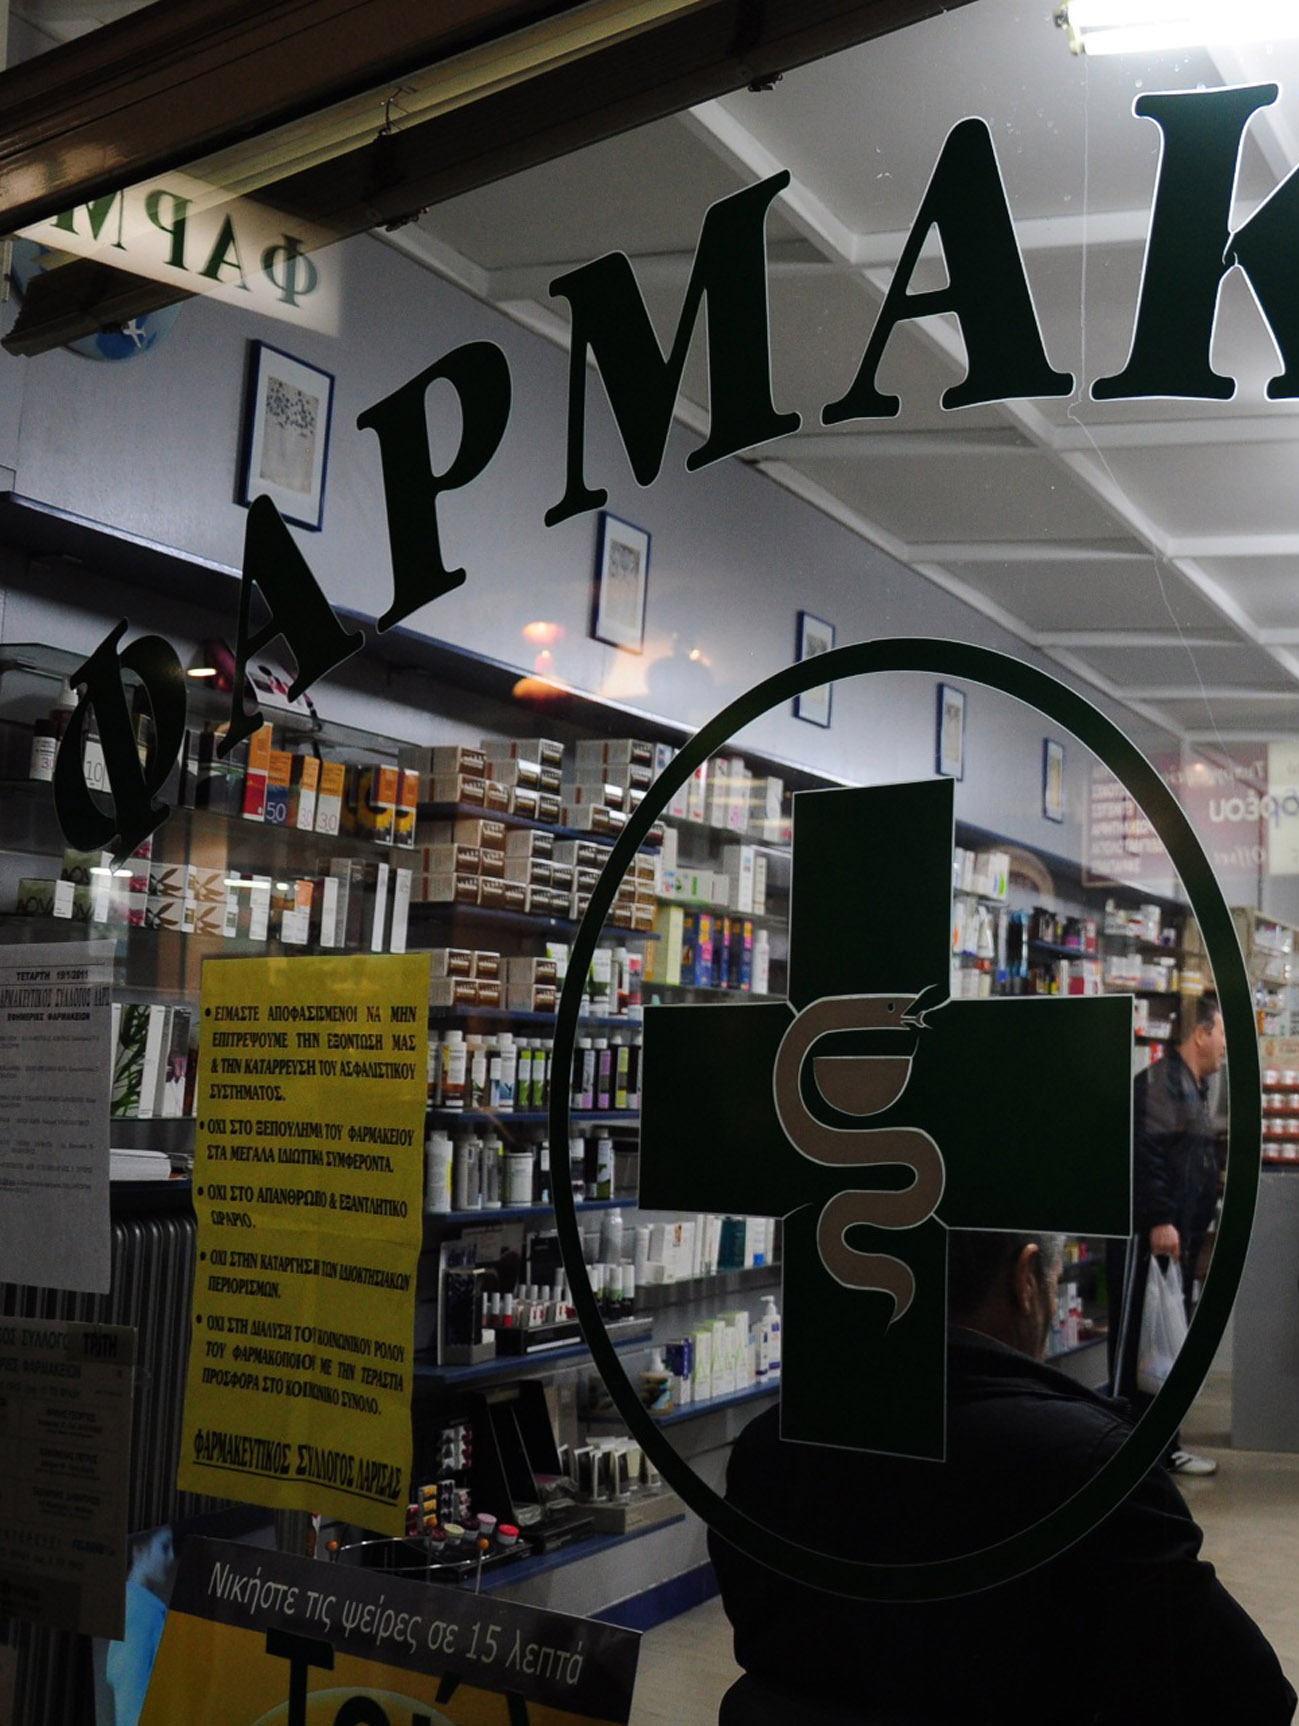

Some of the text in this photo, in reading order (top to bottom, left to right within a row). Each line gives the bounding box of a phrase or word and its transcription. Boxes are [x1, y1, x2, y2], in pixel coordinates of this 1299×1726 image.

[214, 1005, 417, 1023] ΕΙΜΑΣΤΕ ΑΠΟΦΑΣΙΣΜΕΝΟΙ ΝΑ ΜΗΝ
[212, 1032, 416, 1051] ΕΠΙΤΡΕΨΟΥΜΕ ΤΗΝ ΕΞΟΝΤΩΣΗ ΜΑΣ
[221, 1058, 242, 1074] ΤΗΝ
[244, 1058, 316, 1076] ΚΑΤΑΡΡΕΥΣΗ
[319, 1060, 338, 1077] ΤΟΥ
[340, 1061, 416, 1080] ΑΣΦΑΛΙΣΤΙΚΟΥ
[207, 1119, 227, 1135] ΟΧΙ
[230, 1119, 253, 1136] ΣΤΟ
[325, 1123, 344, 1141] ΤΟΥ
[347, 1125, 415, 1147] ΦΑΡΜΑΚΕΙΟΥ
[207, 1145, 227, 1161] ΣΤΑ
[230, 1146, 275, 1163] ΜΕΓΑΛΑ
[207, 1184, 227, 1201] ΟΧΙ
[230, 1185, 254, 1202] ΣΤΟ
[210, 1249, 227, 1267] ΟΧΙ
[229, 1250, 258, 1269] ΣΤΗΝ
[207, 1314, 225, 1331] ΟΧΙ
[227, 1316, 248, 1335] ΣΤΗ
[374, 1340, 405, 1364] ΡΟΛΟΥ
[206, 1340, 226, 1359] ΤΟΥ
[320, 1357, 332, 1376] ΜΕ
[337, 1361, 356, 1381] ΤΗΝ
[361, 1366, 404, 1392] ΤΕΡΑΣΤΙΑ
[202, 1366, 260, 1390] ΠΡΟΣΦΟΡΑ
[262, 1376, 283, 1395] ΣΤΟ
[193, 1428, 402, 1500] ΦΑΡΜΑΚΕΥΤΙΚΟΣ ΣΥΛΛΟΓΟΣ ΛΑΡΙΣΑΣ
[208, 1561, 299, 1616] Νικήστε
[306, 1590, 335, 1633] τις
[341, 1594, 422, 1654] ψείρες
[427, 1623, 457, 1655] σε
[466, 1621, 503, 1665] 15
[505, 1628, 585, 1686] λεπτά
